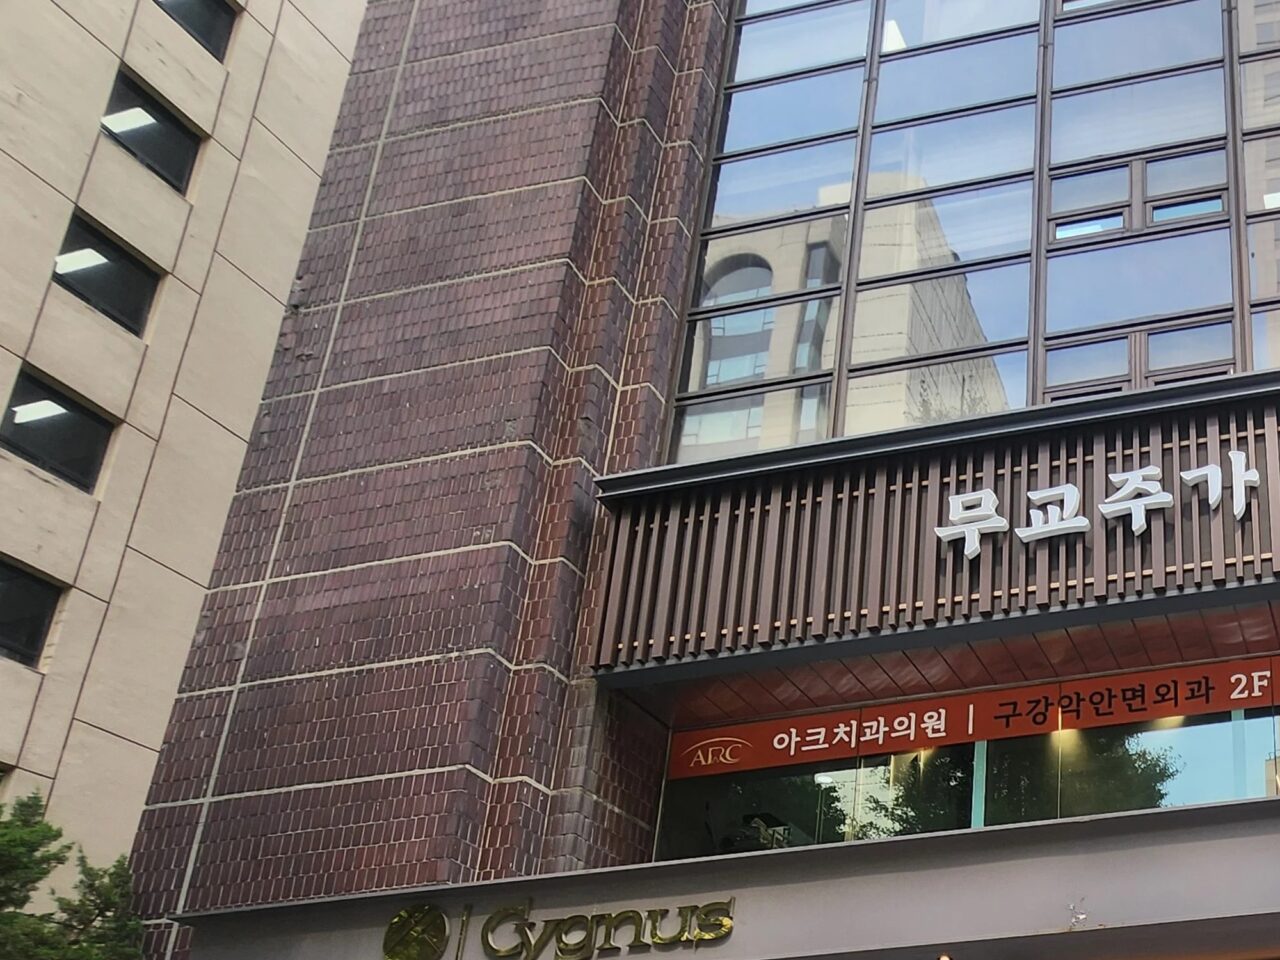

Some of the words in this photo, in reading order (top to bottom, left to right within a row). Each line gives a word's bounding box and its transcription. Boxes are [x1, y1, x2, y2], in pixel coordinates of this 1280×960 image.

[934, 450, 1260, 560] 무교주가
[689, 743, 742, 767] ARC
[772, 708, 947, 756] 아크치과의원
[993, 676, 1216, 730] 구강악안면외과
[1229, 670, 1271, 700] 2F
